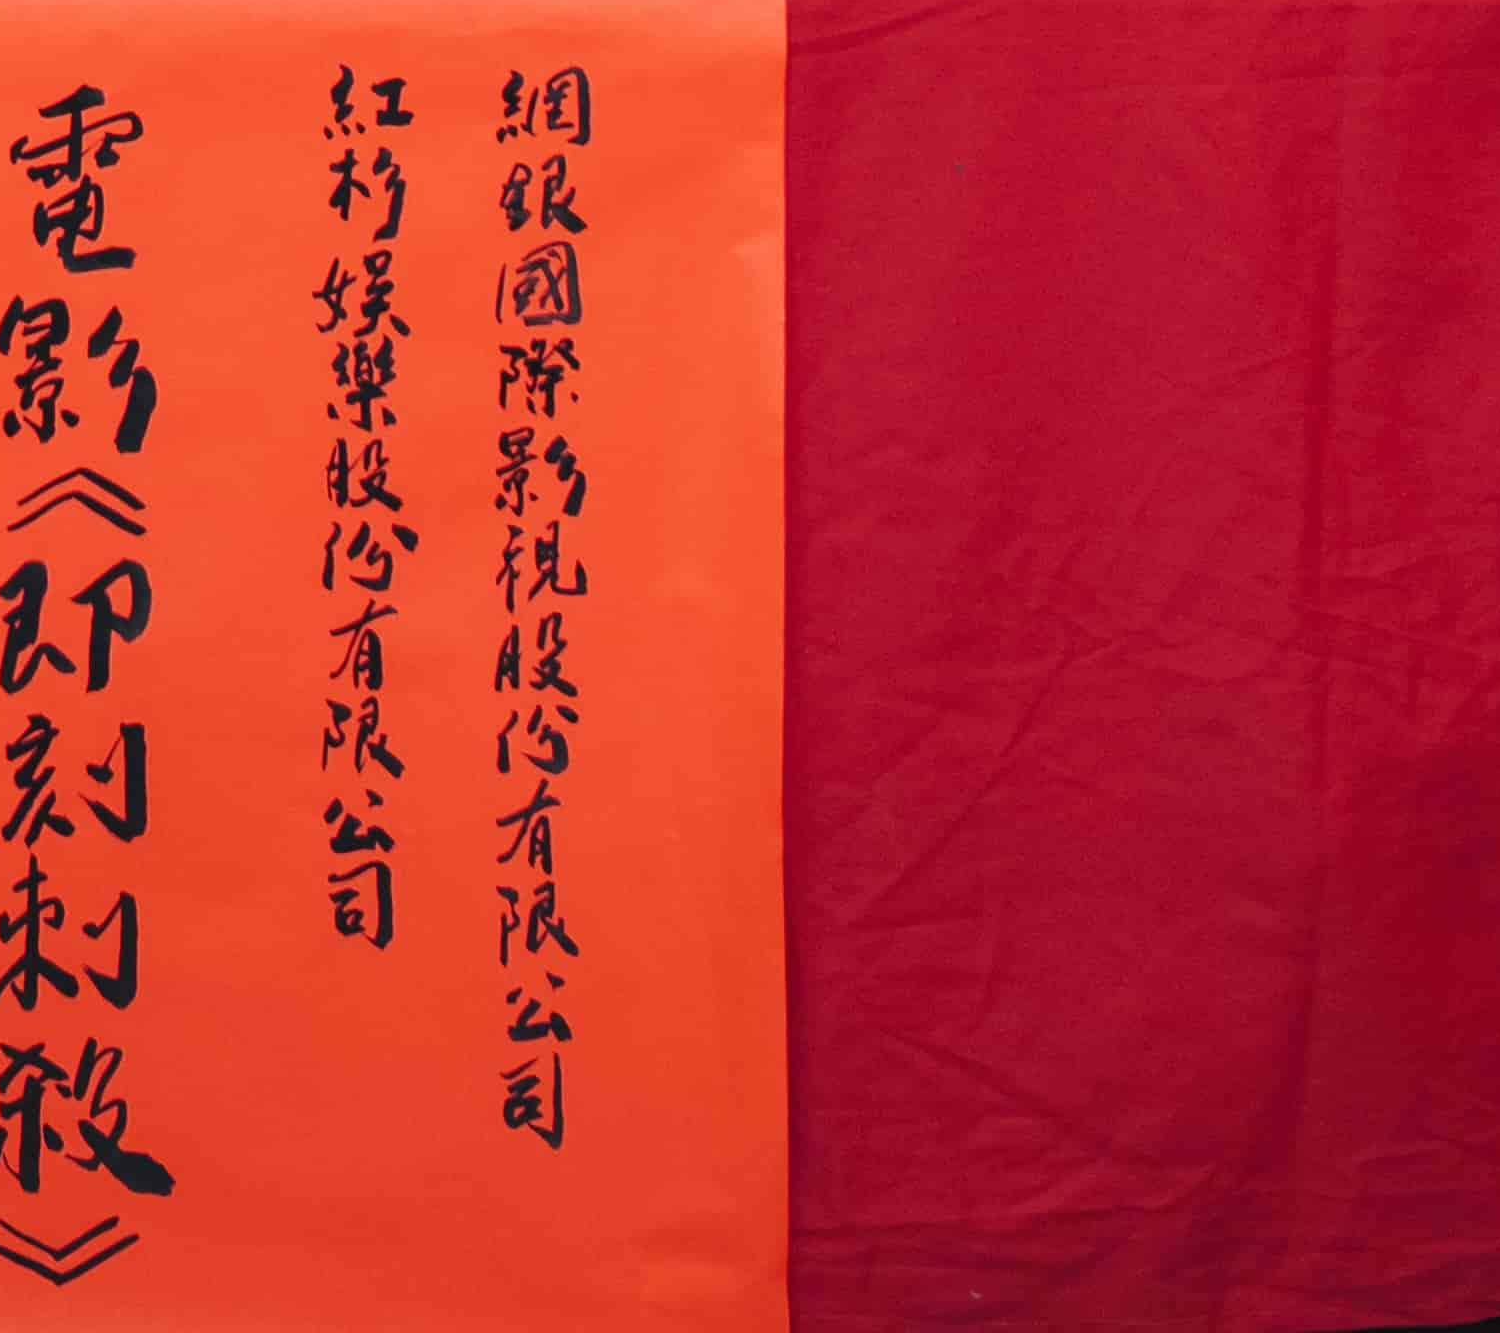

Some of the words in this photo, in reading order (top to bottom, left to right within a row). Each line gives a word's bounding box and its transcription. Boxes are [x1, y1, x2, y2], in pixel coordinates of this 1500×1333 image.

[311, 63, 418, 952] 紅杉娛樂股份有限公司
[494, 64, 590, 1150] 網銀國際影視股份有限公司
